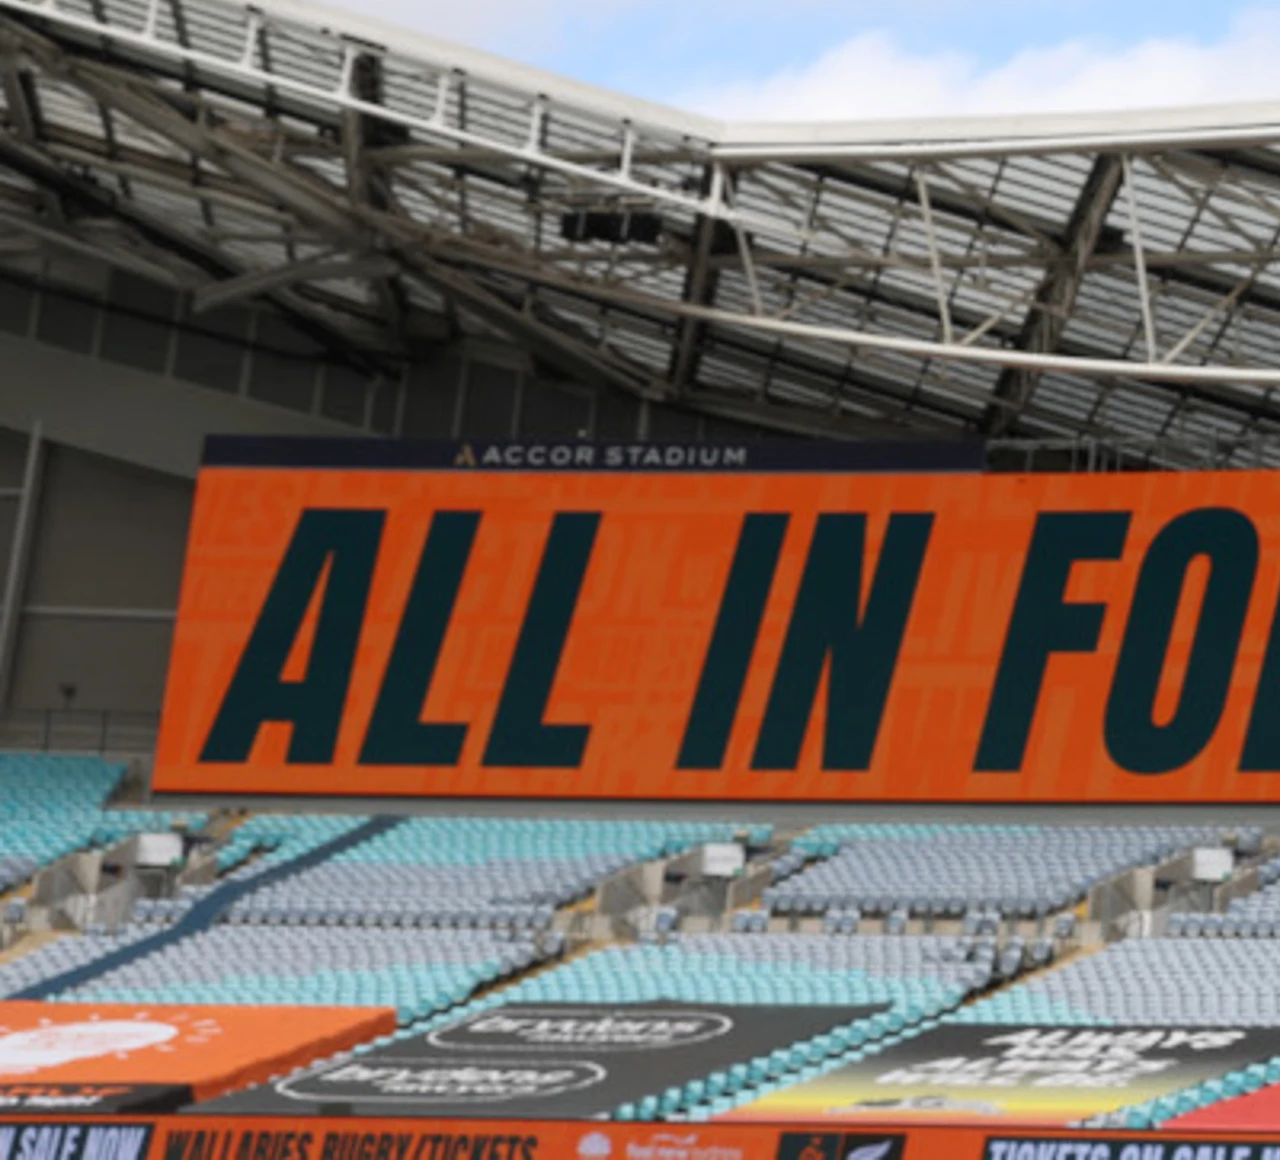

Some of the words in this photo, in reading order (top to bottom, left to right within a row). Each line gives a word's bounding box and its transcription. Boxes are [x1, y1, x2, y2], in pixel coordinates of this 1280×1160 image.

[482, 445, 594, 466] ACCOR
[604, 445, 748, 466] STADIUM
[199, 507, 604, 768] ALL
[675, 511, 936, 771] IN
